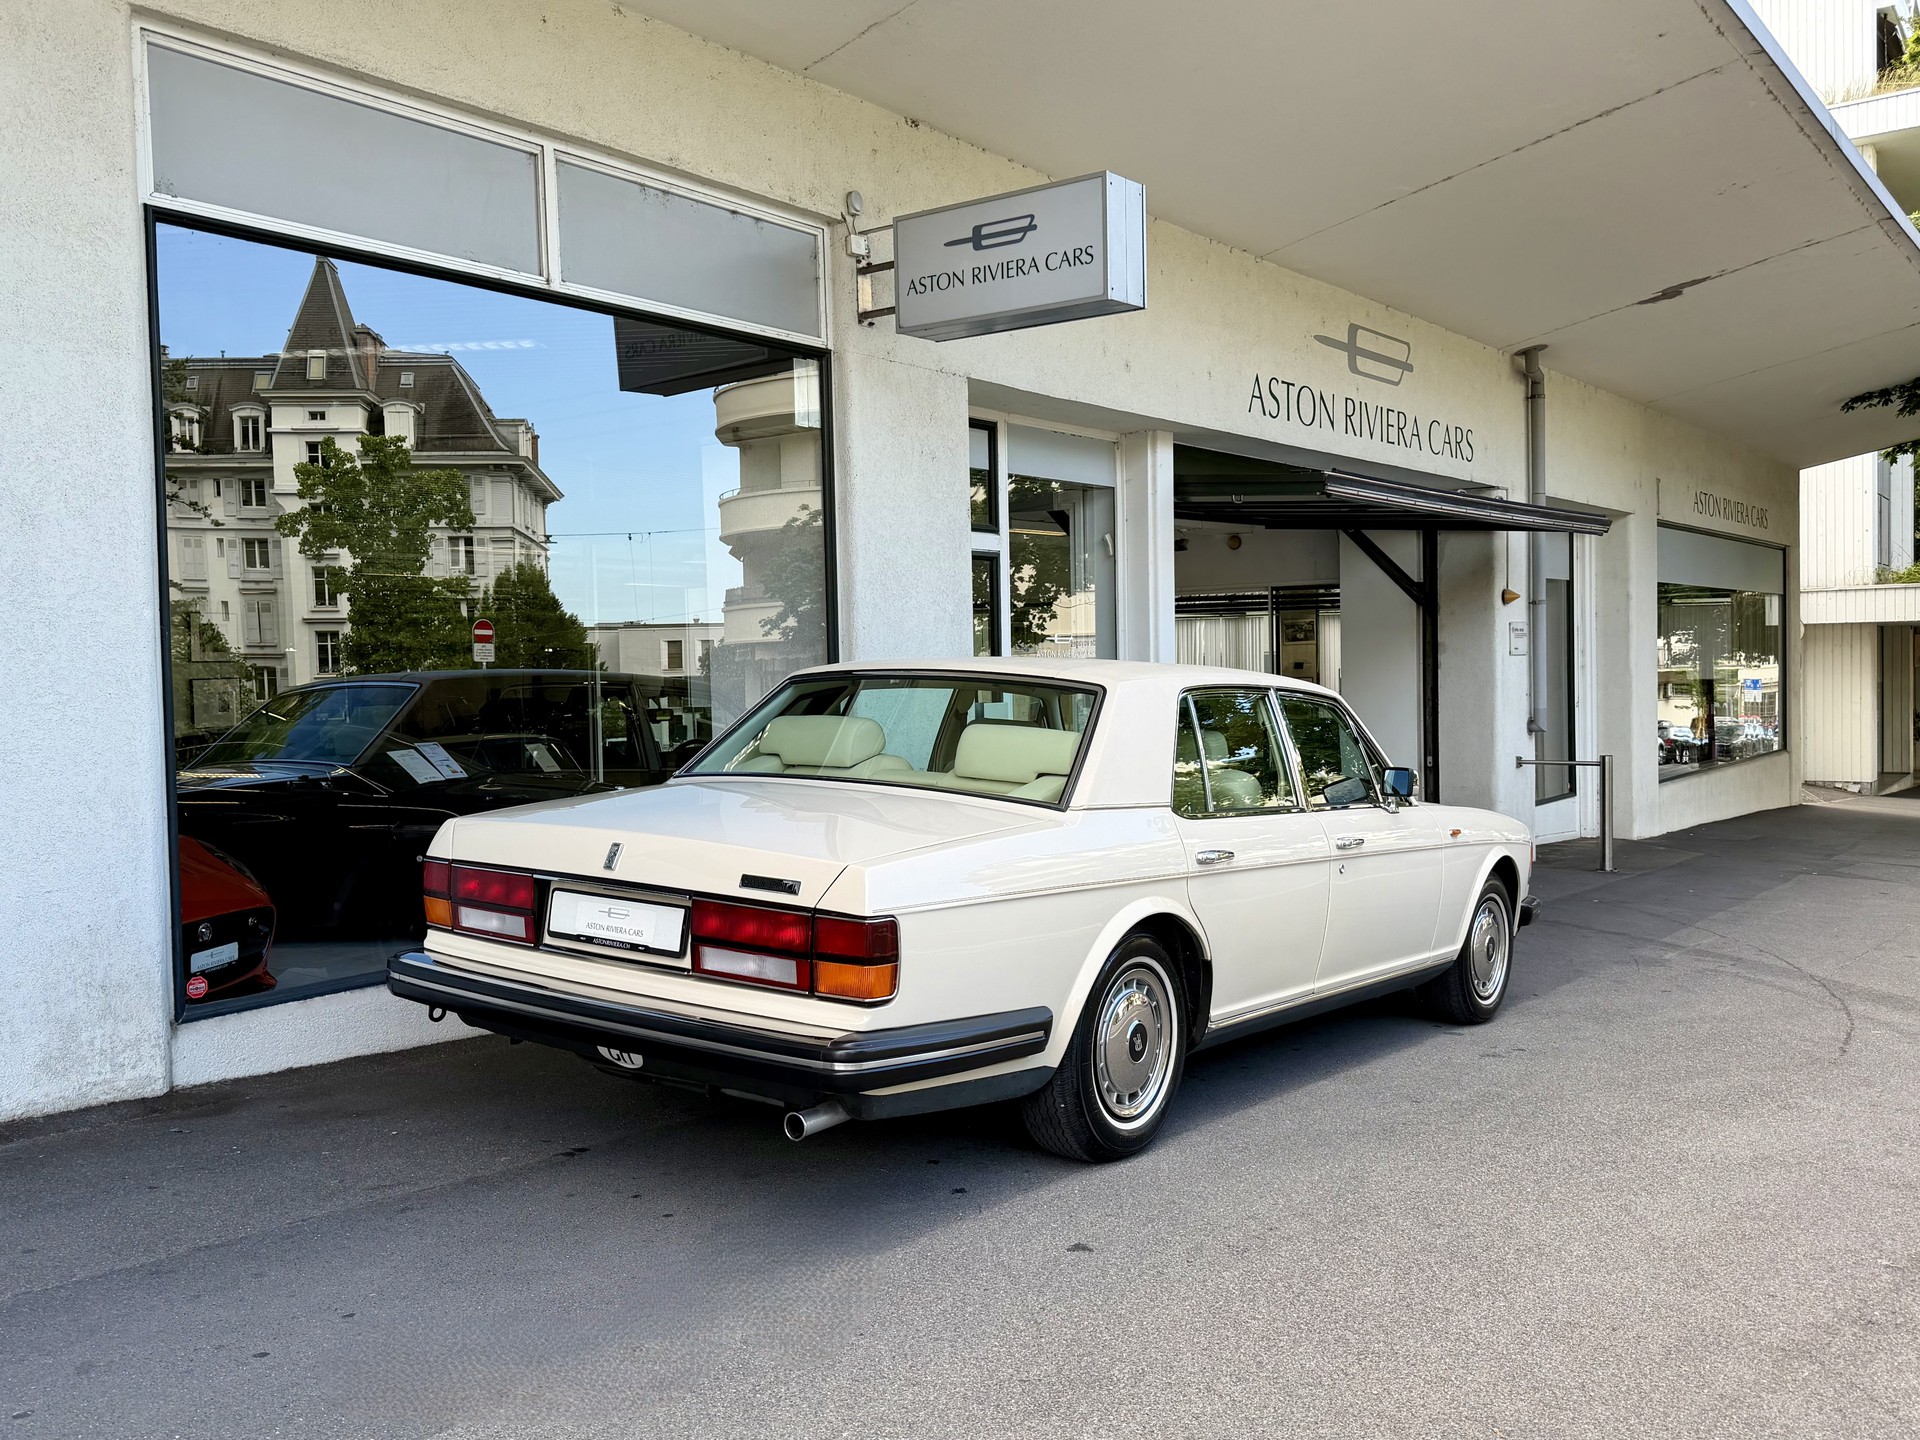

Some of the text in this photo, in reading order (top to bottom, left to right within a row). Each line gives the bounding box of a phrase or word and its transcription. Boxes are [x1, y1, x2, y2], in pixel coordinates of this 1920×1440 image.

[907, 245, 1095, 297] ASTON RIVIERA CARS
[1248, 373, 1475, 463] ASTON RIVIERA CARS
[1693, 490, 1769, 530] ASTON RIVIERA CARS
[586, 922, 644, 938] ASTON RIVIERA CARS
